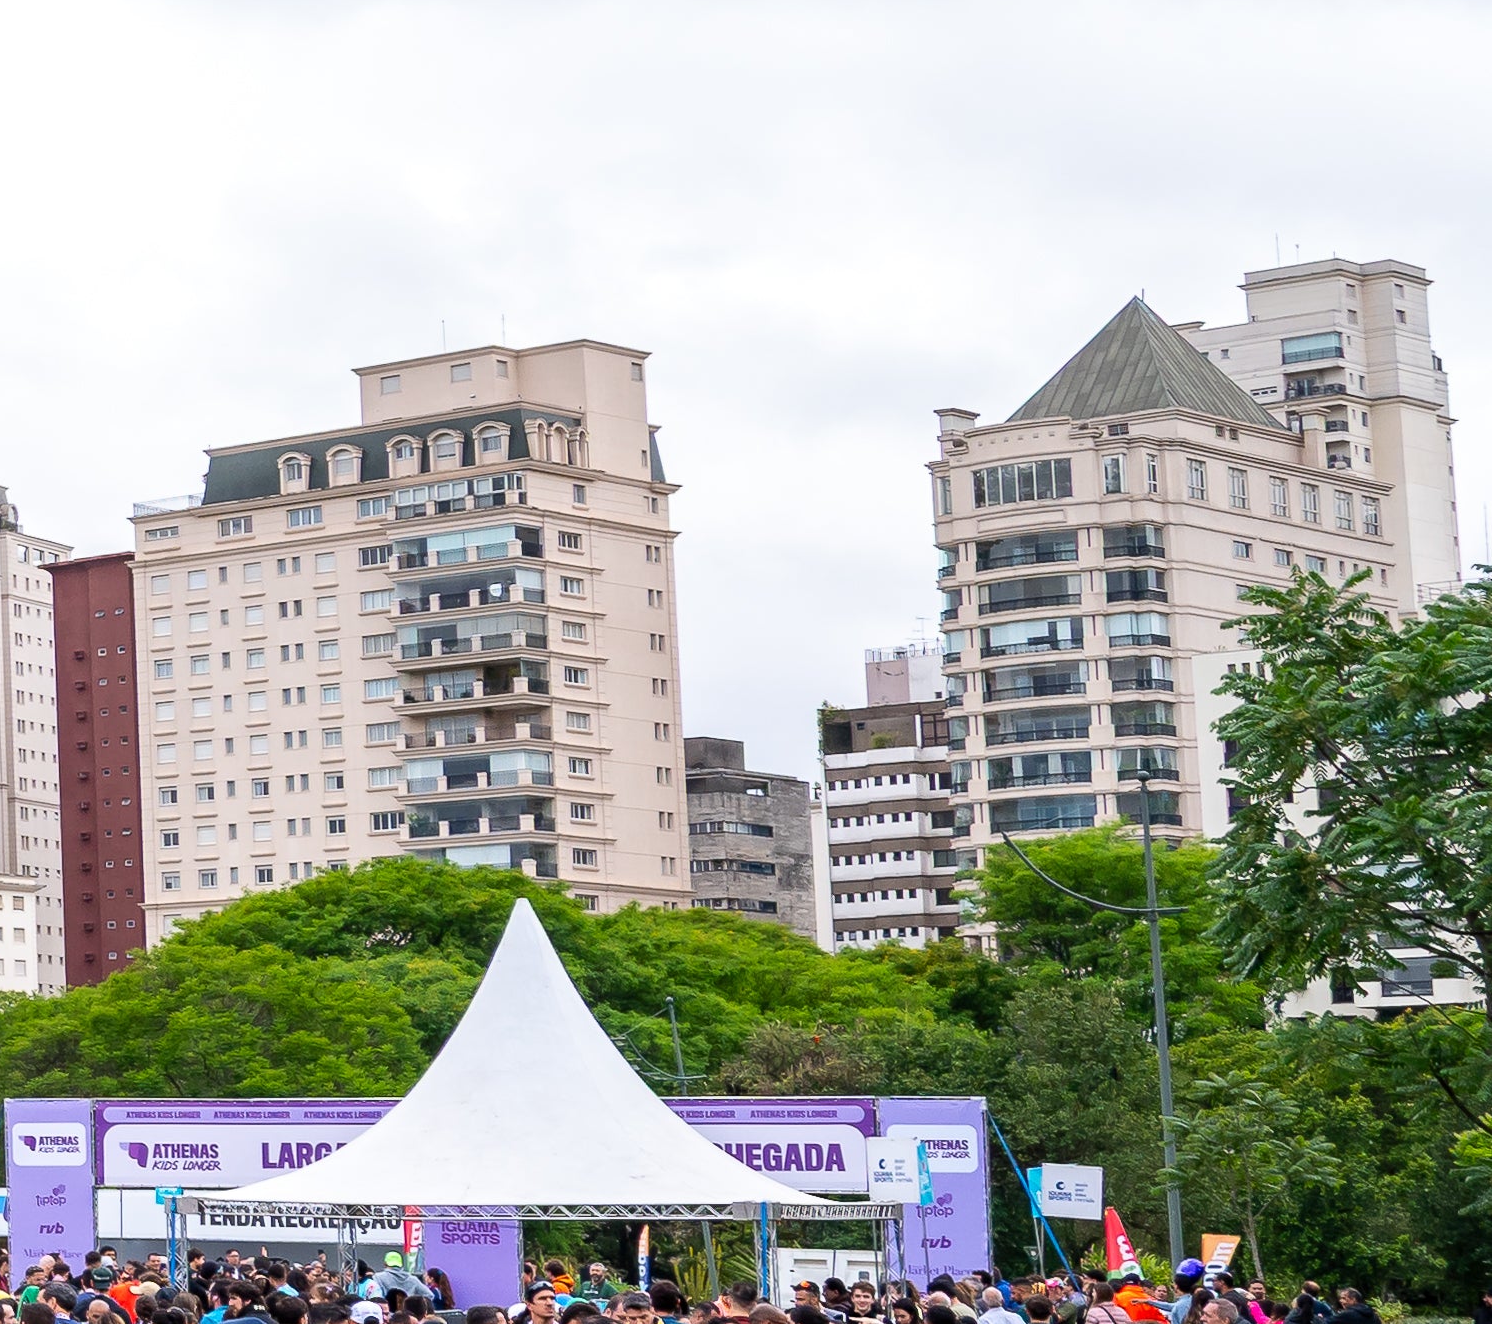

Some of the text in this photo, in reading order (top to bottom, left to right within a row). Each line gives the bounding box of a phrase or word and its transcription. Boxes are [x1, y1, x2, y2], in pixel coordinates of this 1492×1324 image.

[39, 1136, 79, 1146] ATHENAS
[153, 1143, 219, 1159] ATHENAS
[151, 1160, 222, 1171] KIDS LONGER
[35, 1193, 67, 1207] tiptop
[915, 1205, 954, 1219] tiptop
[39, 1223, 65, 1235] rvb
[441, 1221, 500, 1233] IGUANA
[441, 1233, 501, 1245] SPORTS
[921, 1236, 951, 1249] rvb
